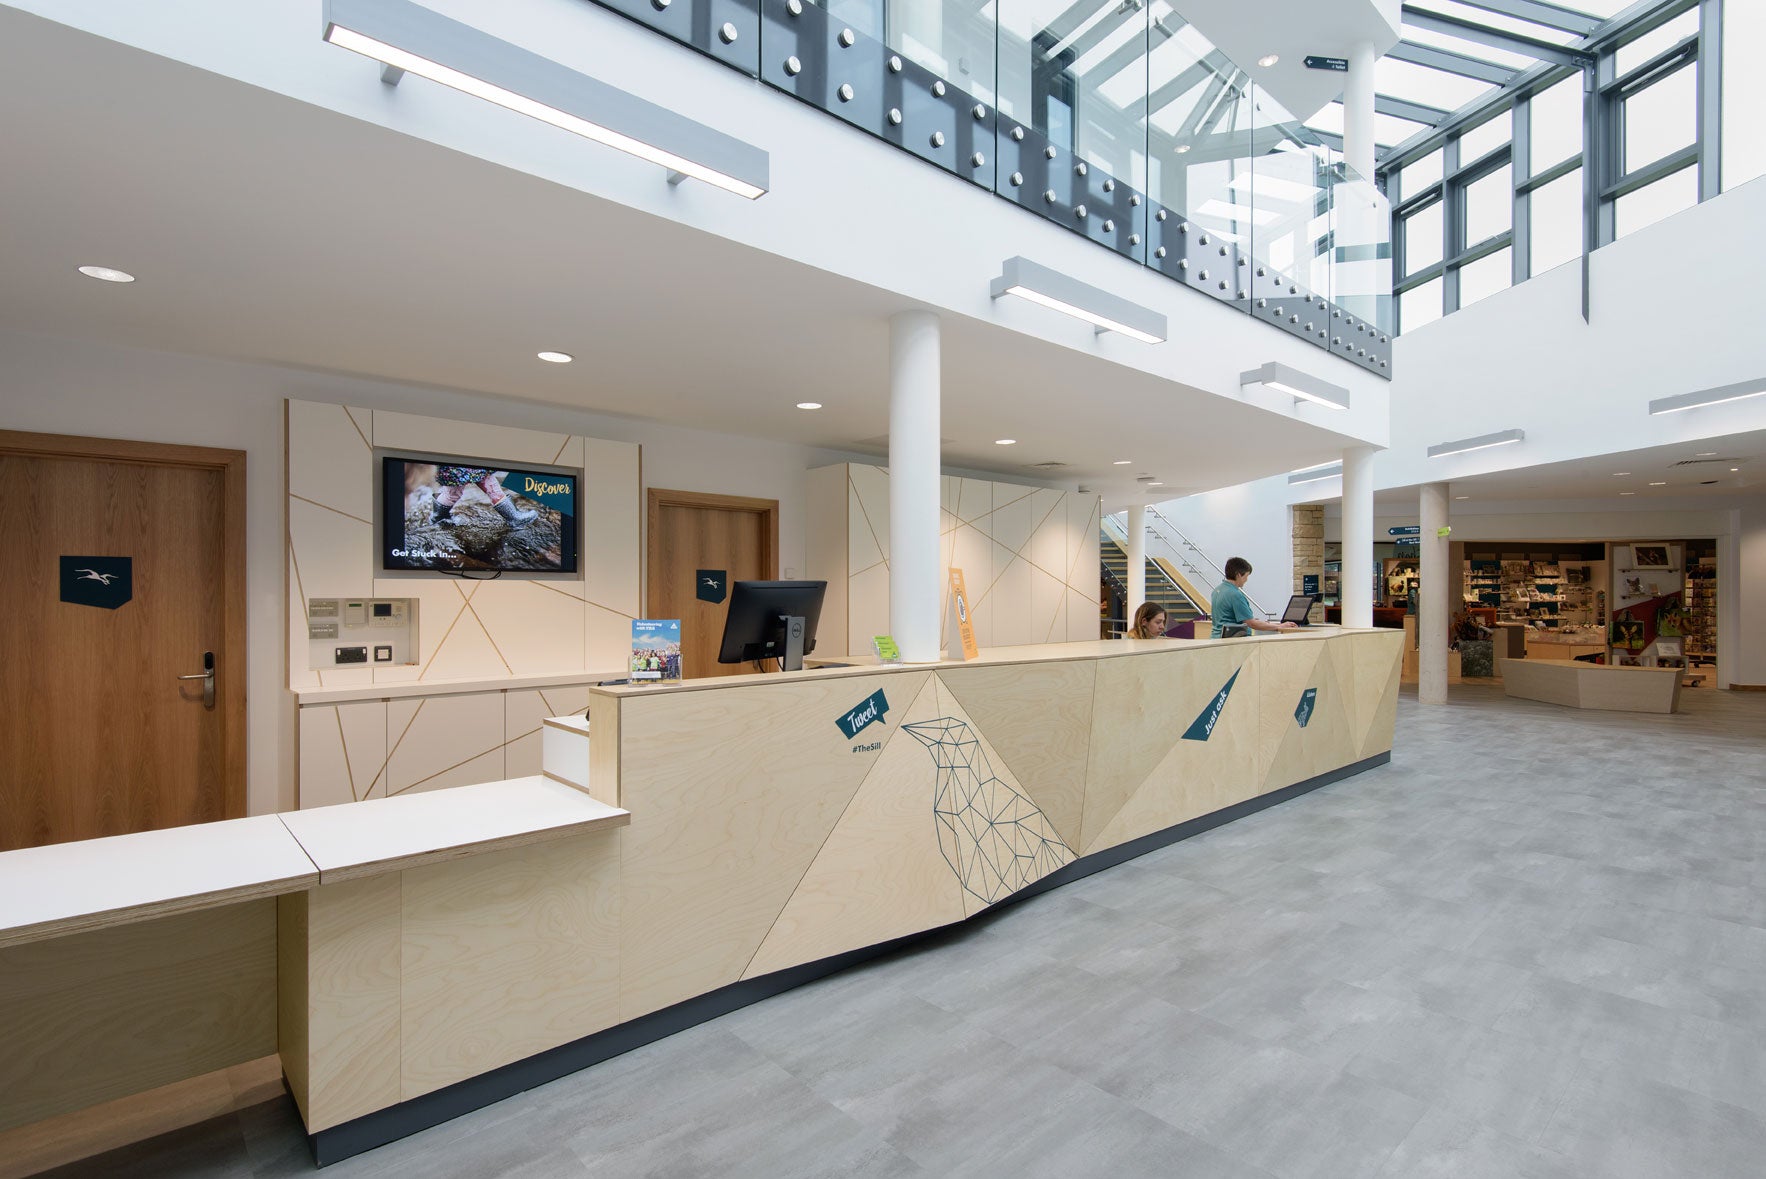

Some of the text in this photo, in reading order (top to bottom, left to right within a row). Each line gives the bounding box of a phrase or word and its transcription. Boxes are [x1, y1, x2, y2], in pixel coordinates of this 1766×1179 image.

[525, 477, 571, 496] Discover
[392, 549, 409, 557] Get
[411, 549, 437, 558] Stuck
[847, 698, 877, 733] Tweet
[1205, 690, 1227, 735] Just ask
[852, 742, 881, 753] #TheSill
